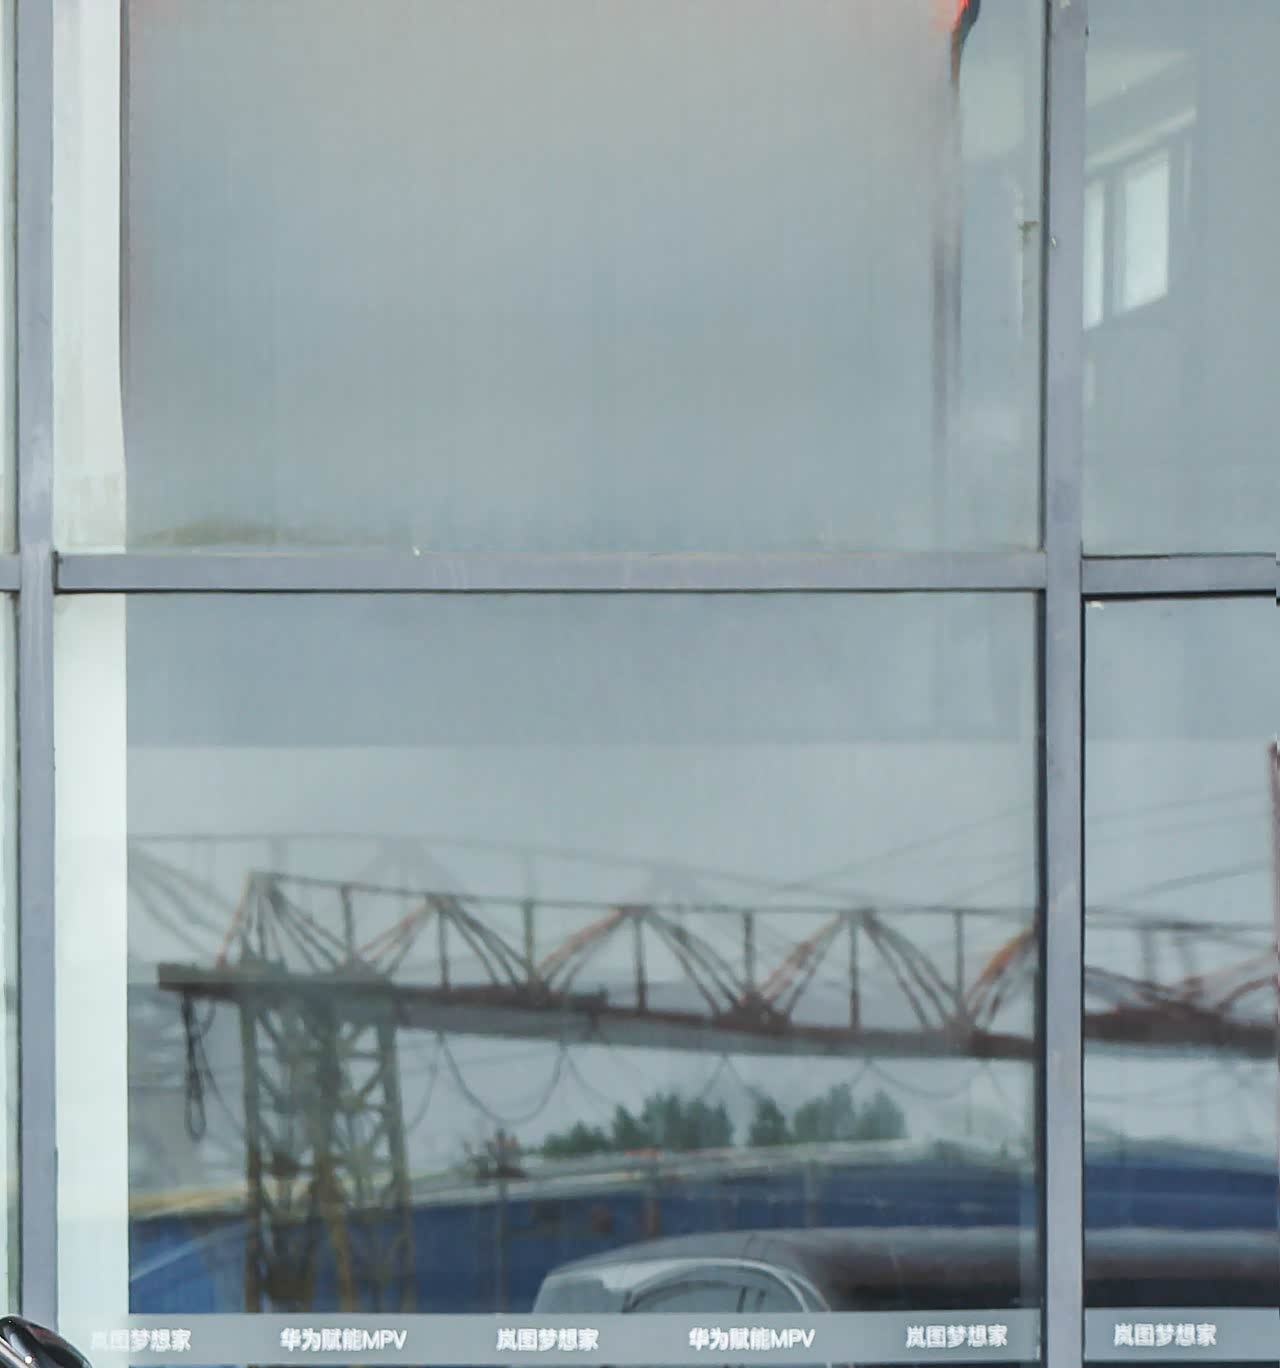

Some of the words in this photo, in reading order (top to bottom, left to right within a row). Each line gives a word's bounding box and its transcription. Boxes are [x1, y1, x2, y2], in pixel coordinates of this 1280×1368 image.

[280, 1328, 407, 1353] 华为赋能MPV
[497, 1328, 599, 1352] 岚图梦想家
[689, 1327, 815, 1351] 华为赋能MPV
[906, 1324, 1008, 1348] 岚图梦想家
[1114, 1323, 1217, 1347] 岚图梦想家
